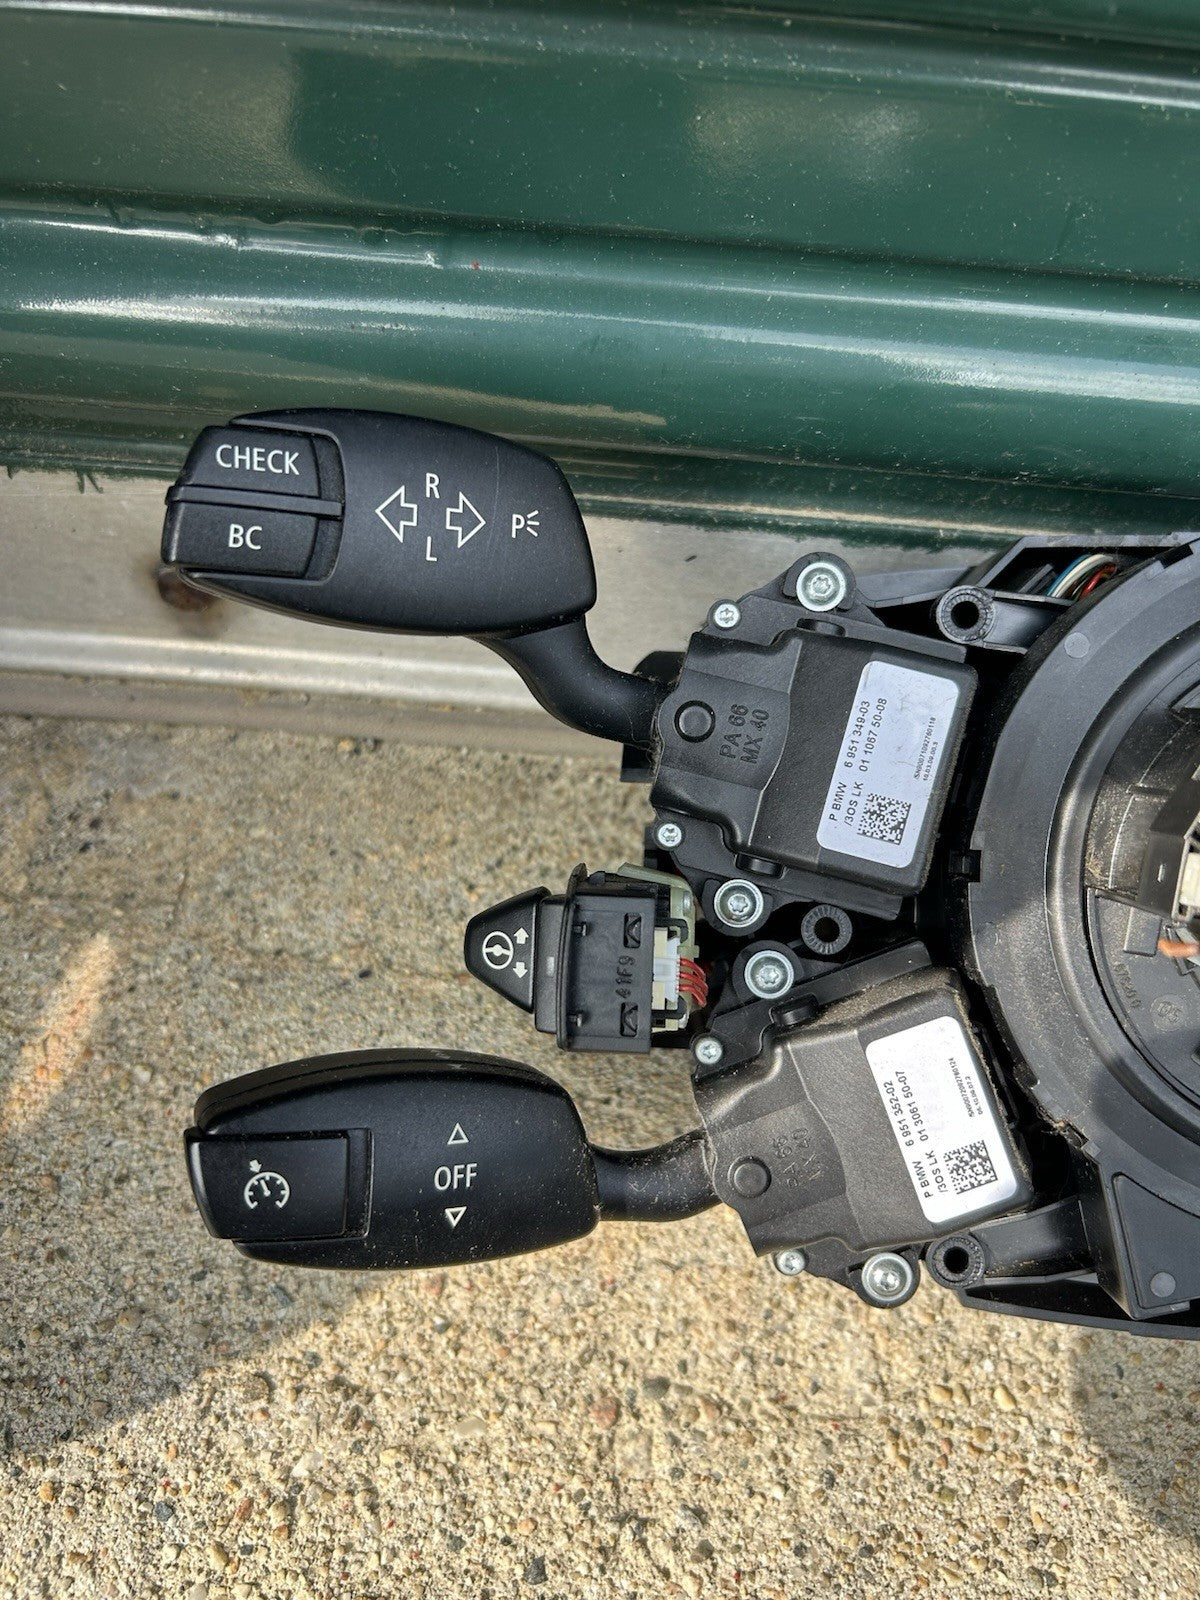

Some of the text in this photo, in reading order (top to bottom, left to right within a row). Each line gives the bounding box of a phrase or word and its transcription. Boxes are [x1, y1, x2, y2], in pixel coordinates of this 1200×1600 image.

[215, 444, 300, 475] CHECK
[425, 472, 440, 499] R
[228, 524, 263, 551] BC
[511, 514, 525, 539] P
[426, 536, 438, 562] L
[873, 697, 888, 729] 50-08
[719, 703, 749, 759] PA 66
[863, 731, 878, 757] 1067
[740, 735, 763, 764] MX
[829, 700, 871, 821] P BMW 6 951 349-03
[858, 759, 869, 772] 01
[854, 781, 865, 797] LK
[895, 1070, 914, 1098] 50-07
[906, 1101, 924, 1127] 3061
[883, 1080, 933, 1198] P BMW 6 951 352-02
[917, 1128, 929, 1142] 01
[925, 1150, 938, 1167] LK
[434, 1163, 477, 1190] OFF
